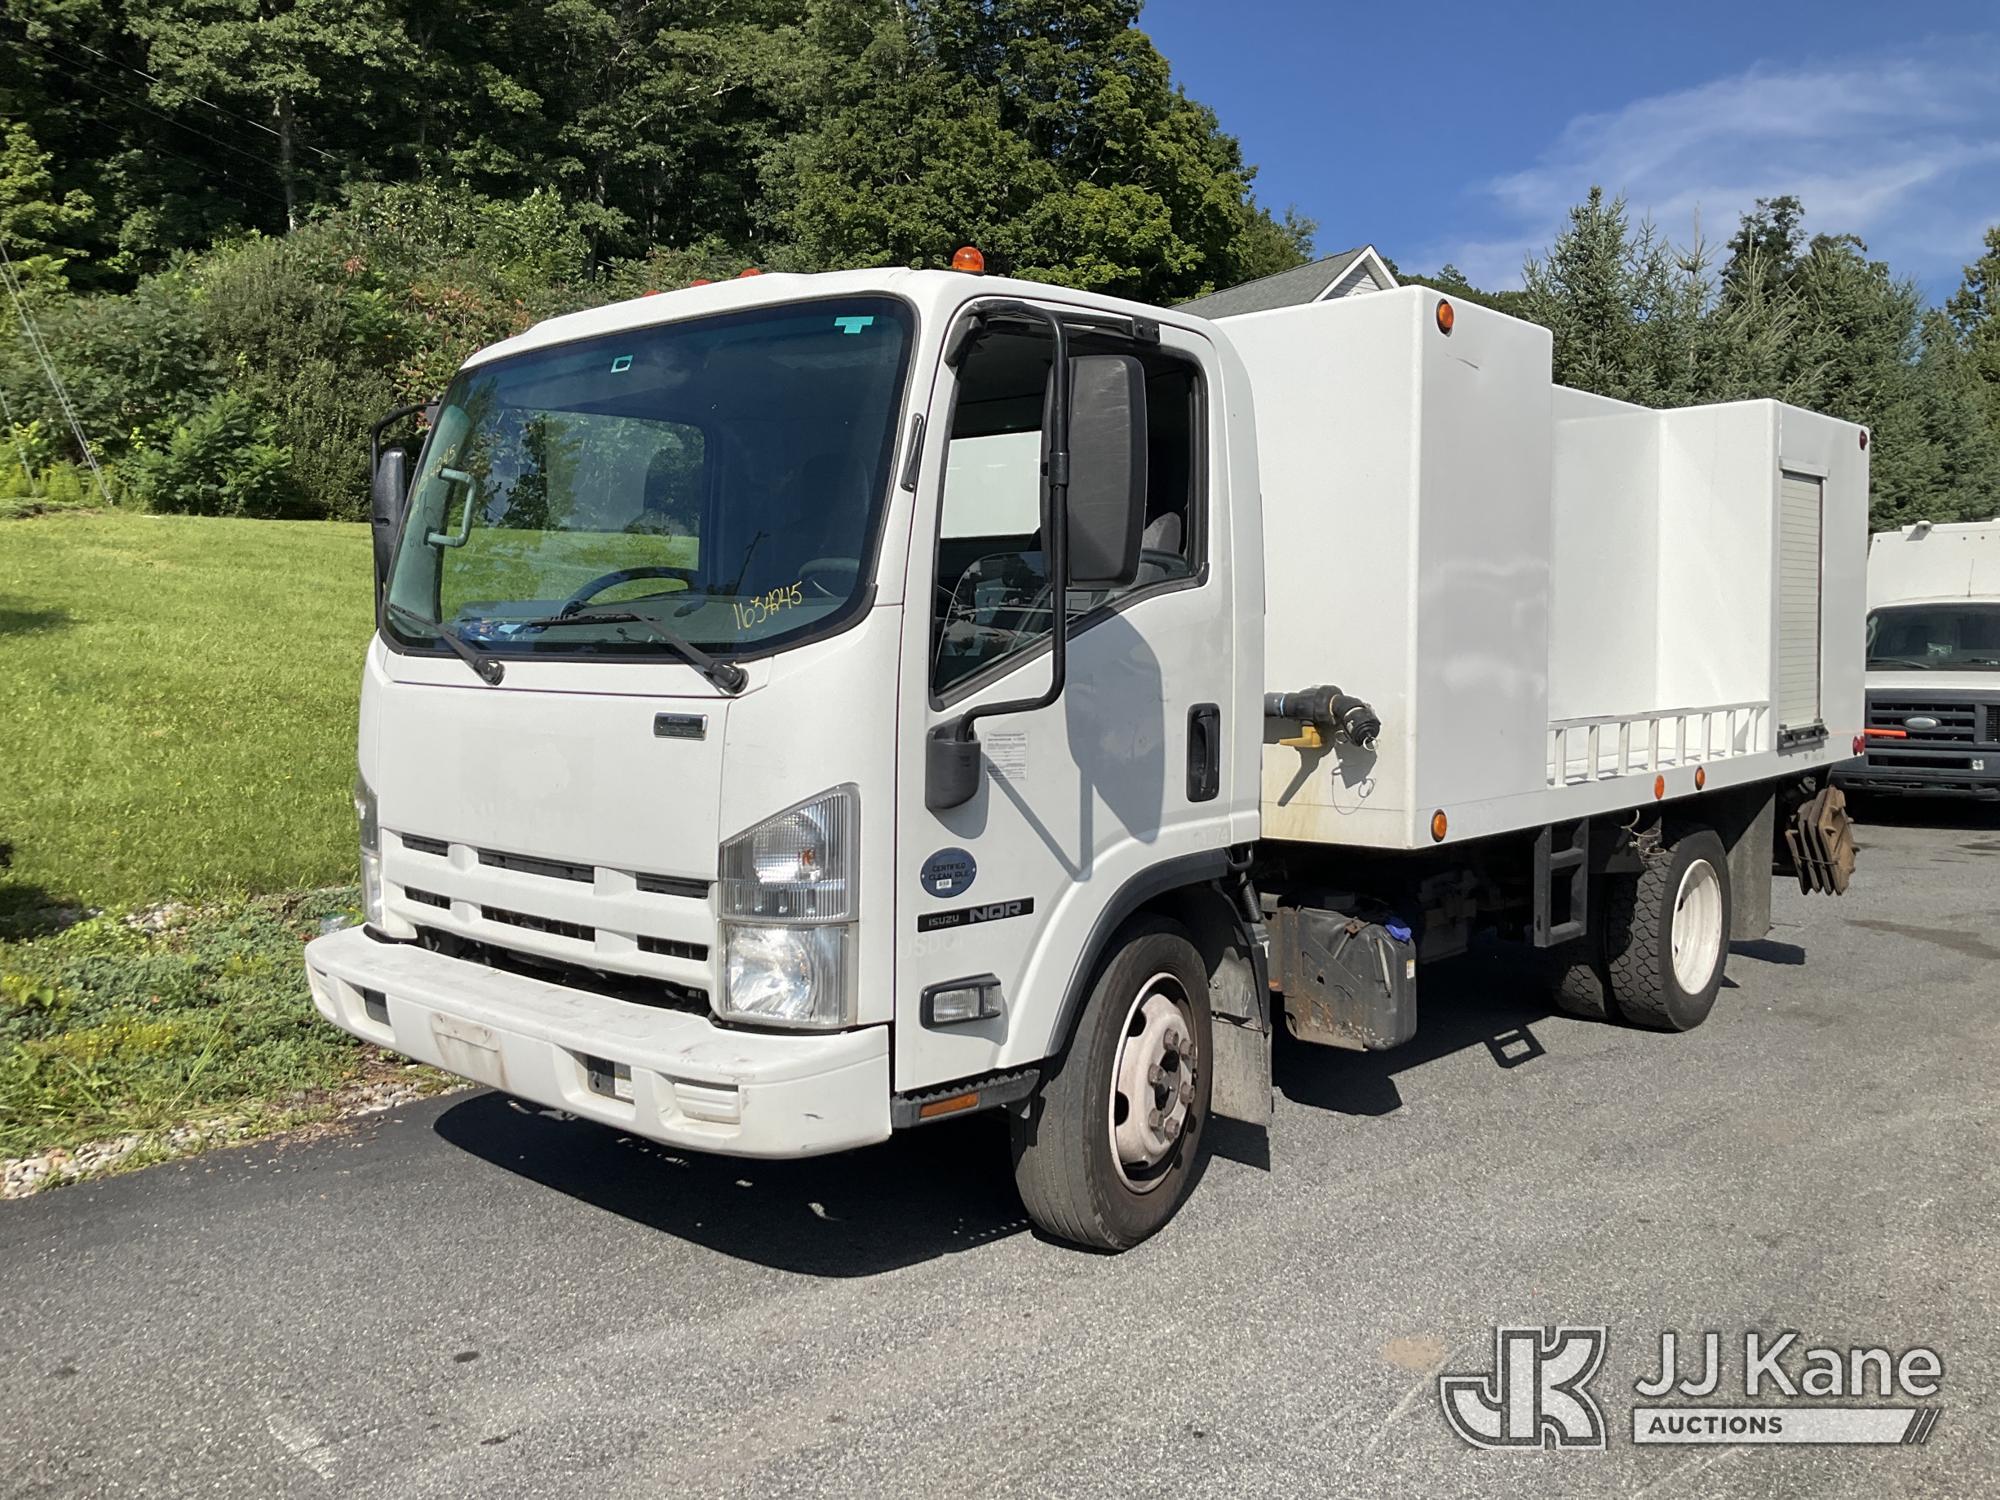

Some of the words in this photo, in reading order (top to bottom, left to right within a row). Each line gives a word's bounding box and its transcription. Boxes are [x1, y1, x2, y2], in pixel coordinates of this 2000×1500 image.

[932, 862, 966, 873] CERTIFIED
[928, 871, 952, 881] CLEAN
[954, 869, 970, 878] IDLE
[928, 914, 960, 927] ISUZU
[969, 901, 1022, 923] NQR
